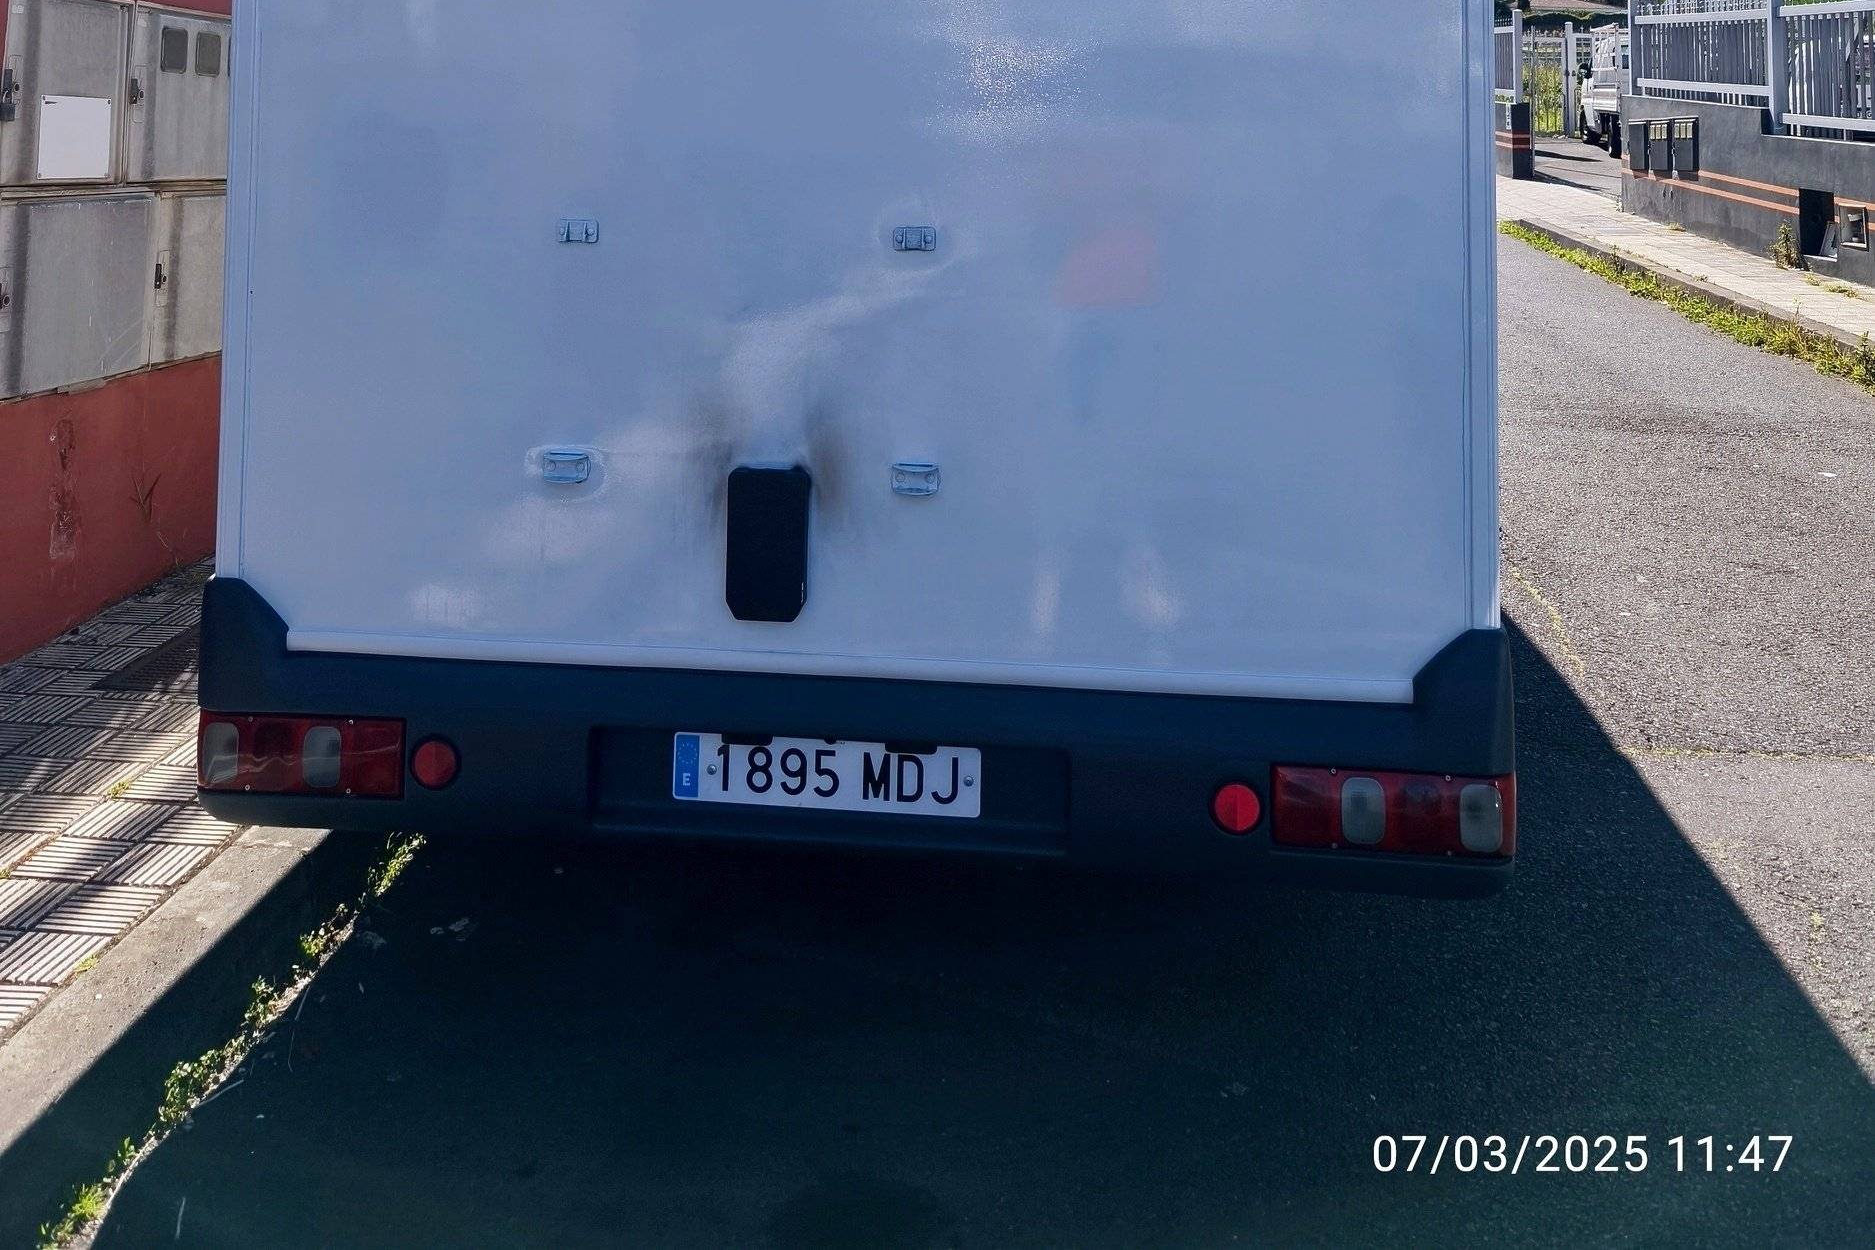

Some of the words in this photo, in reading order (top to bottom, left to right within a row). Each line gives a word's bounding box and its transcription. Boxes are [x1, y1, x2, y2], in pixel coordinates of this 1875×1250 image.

[682, 772, 692, 786] E
[717, 745, 840, 798] 1895
[862, 752, 960, 805] MDJ
